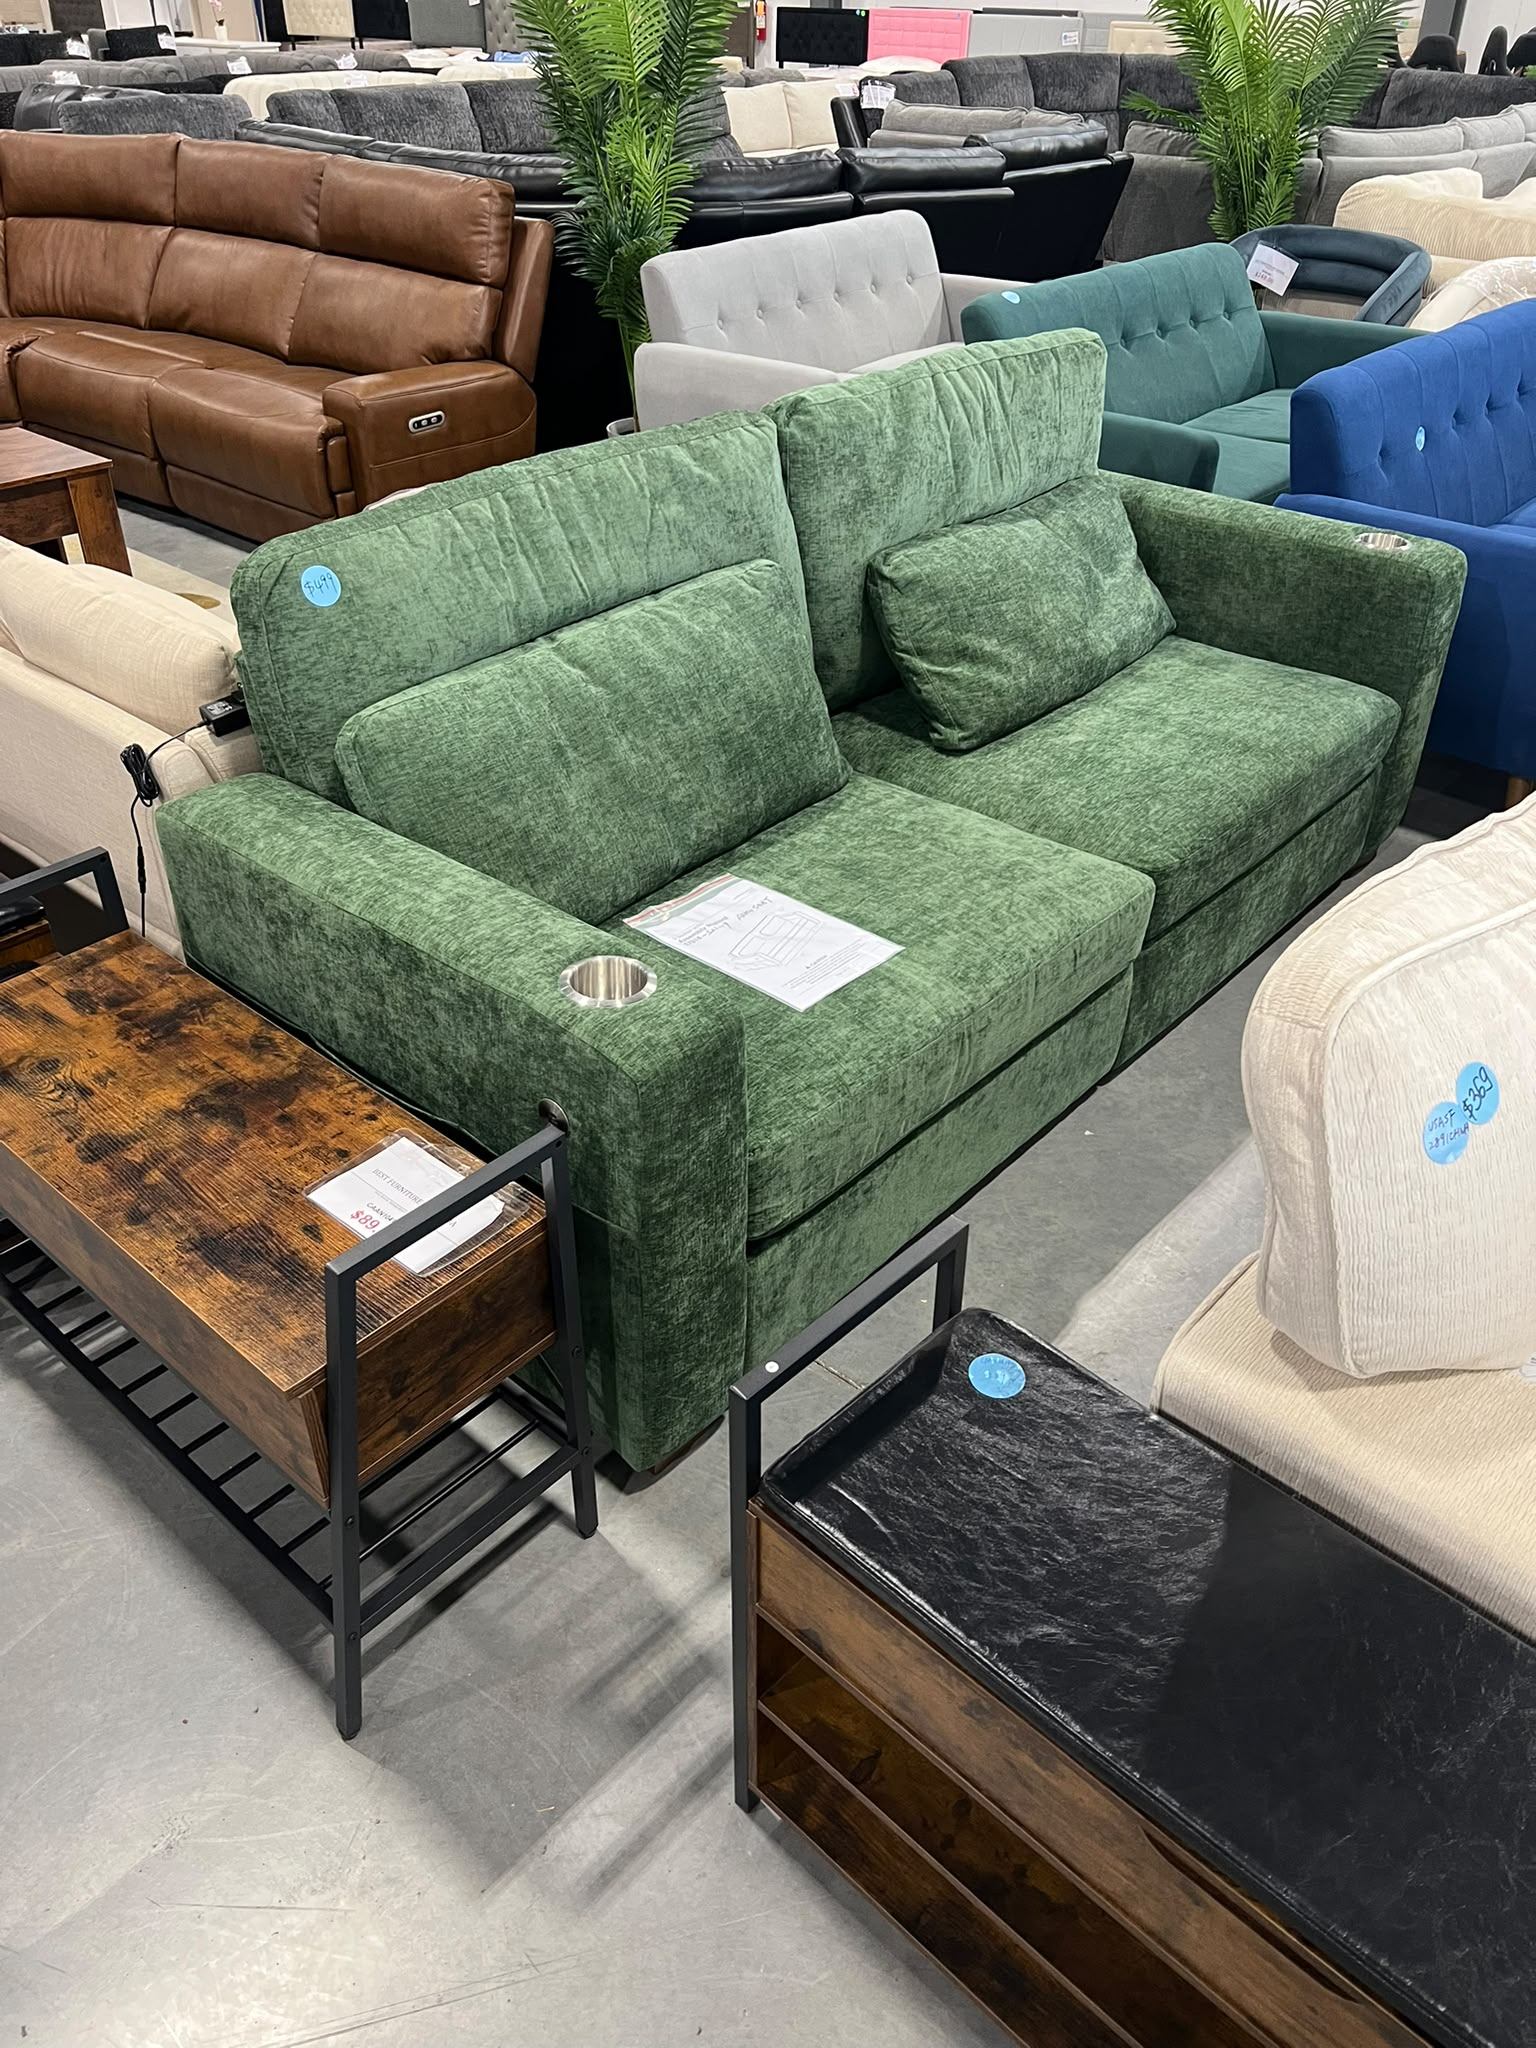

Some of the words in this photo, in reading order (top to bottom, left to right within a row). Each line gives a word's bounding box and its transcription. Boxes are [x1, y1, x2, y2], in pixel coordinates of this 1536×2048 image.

[304, 572, 338, 597] $499
[1462, 1066, 1493, 1121] $369
[372, 1168, 390, 1182] BEST
[386, 1177, 423, 1205] FURNITURE
